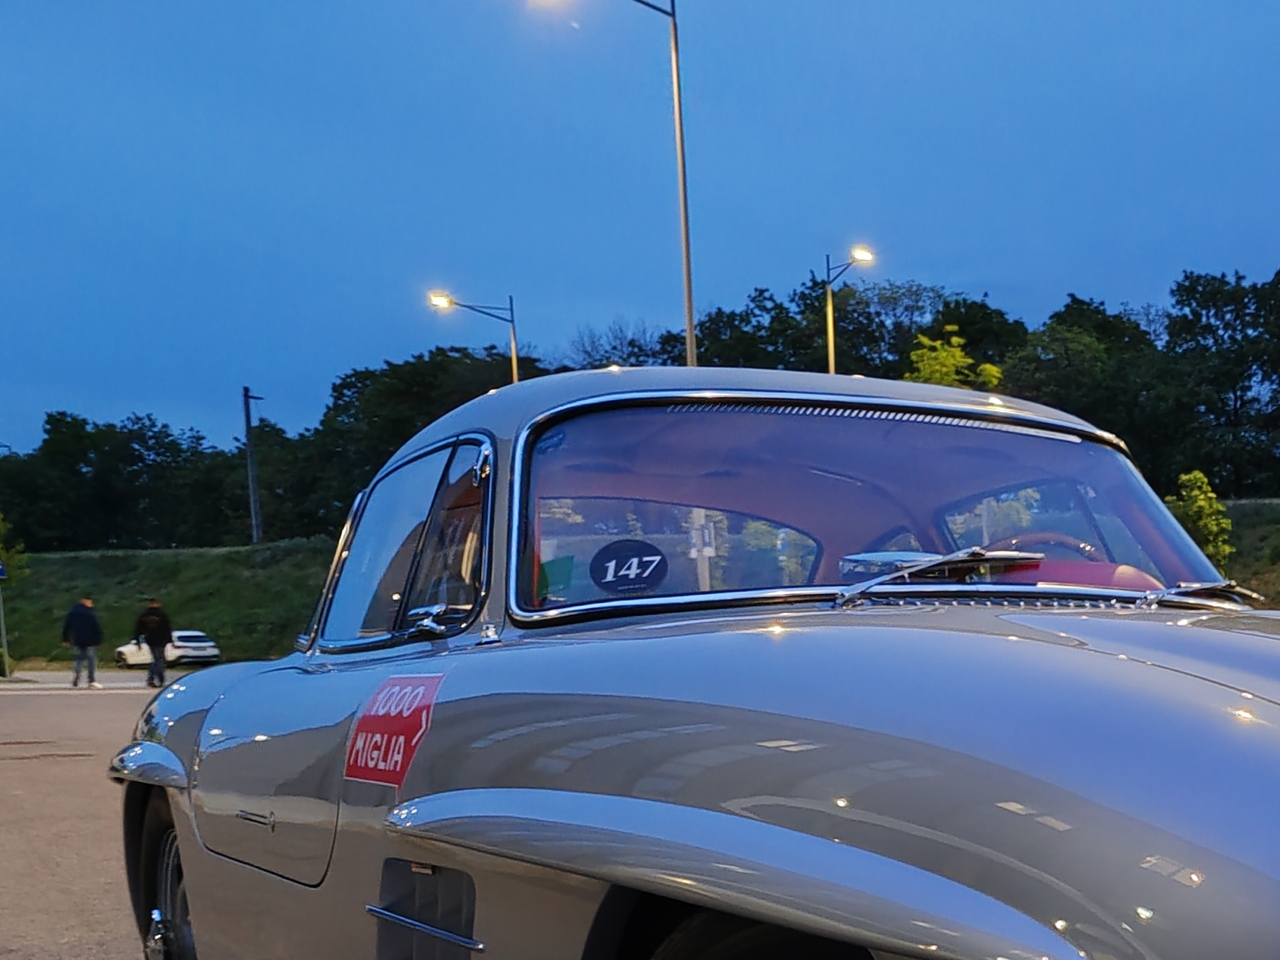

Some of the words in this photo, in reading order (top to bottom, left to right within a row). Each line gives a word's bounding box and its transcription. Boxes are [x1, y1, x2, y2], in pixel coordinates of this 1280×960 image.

[601, 555, 662, 583] 147
[370, 685, 426, 717] 1000
[349, 731, 406, 772] MIGLIA
